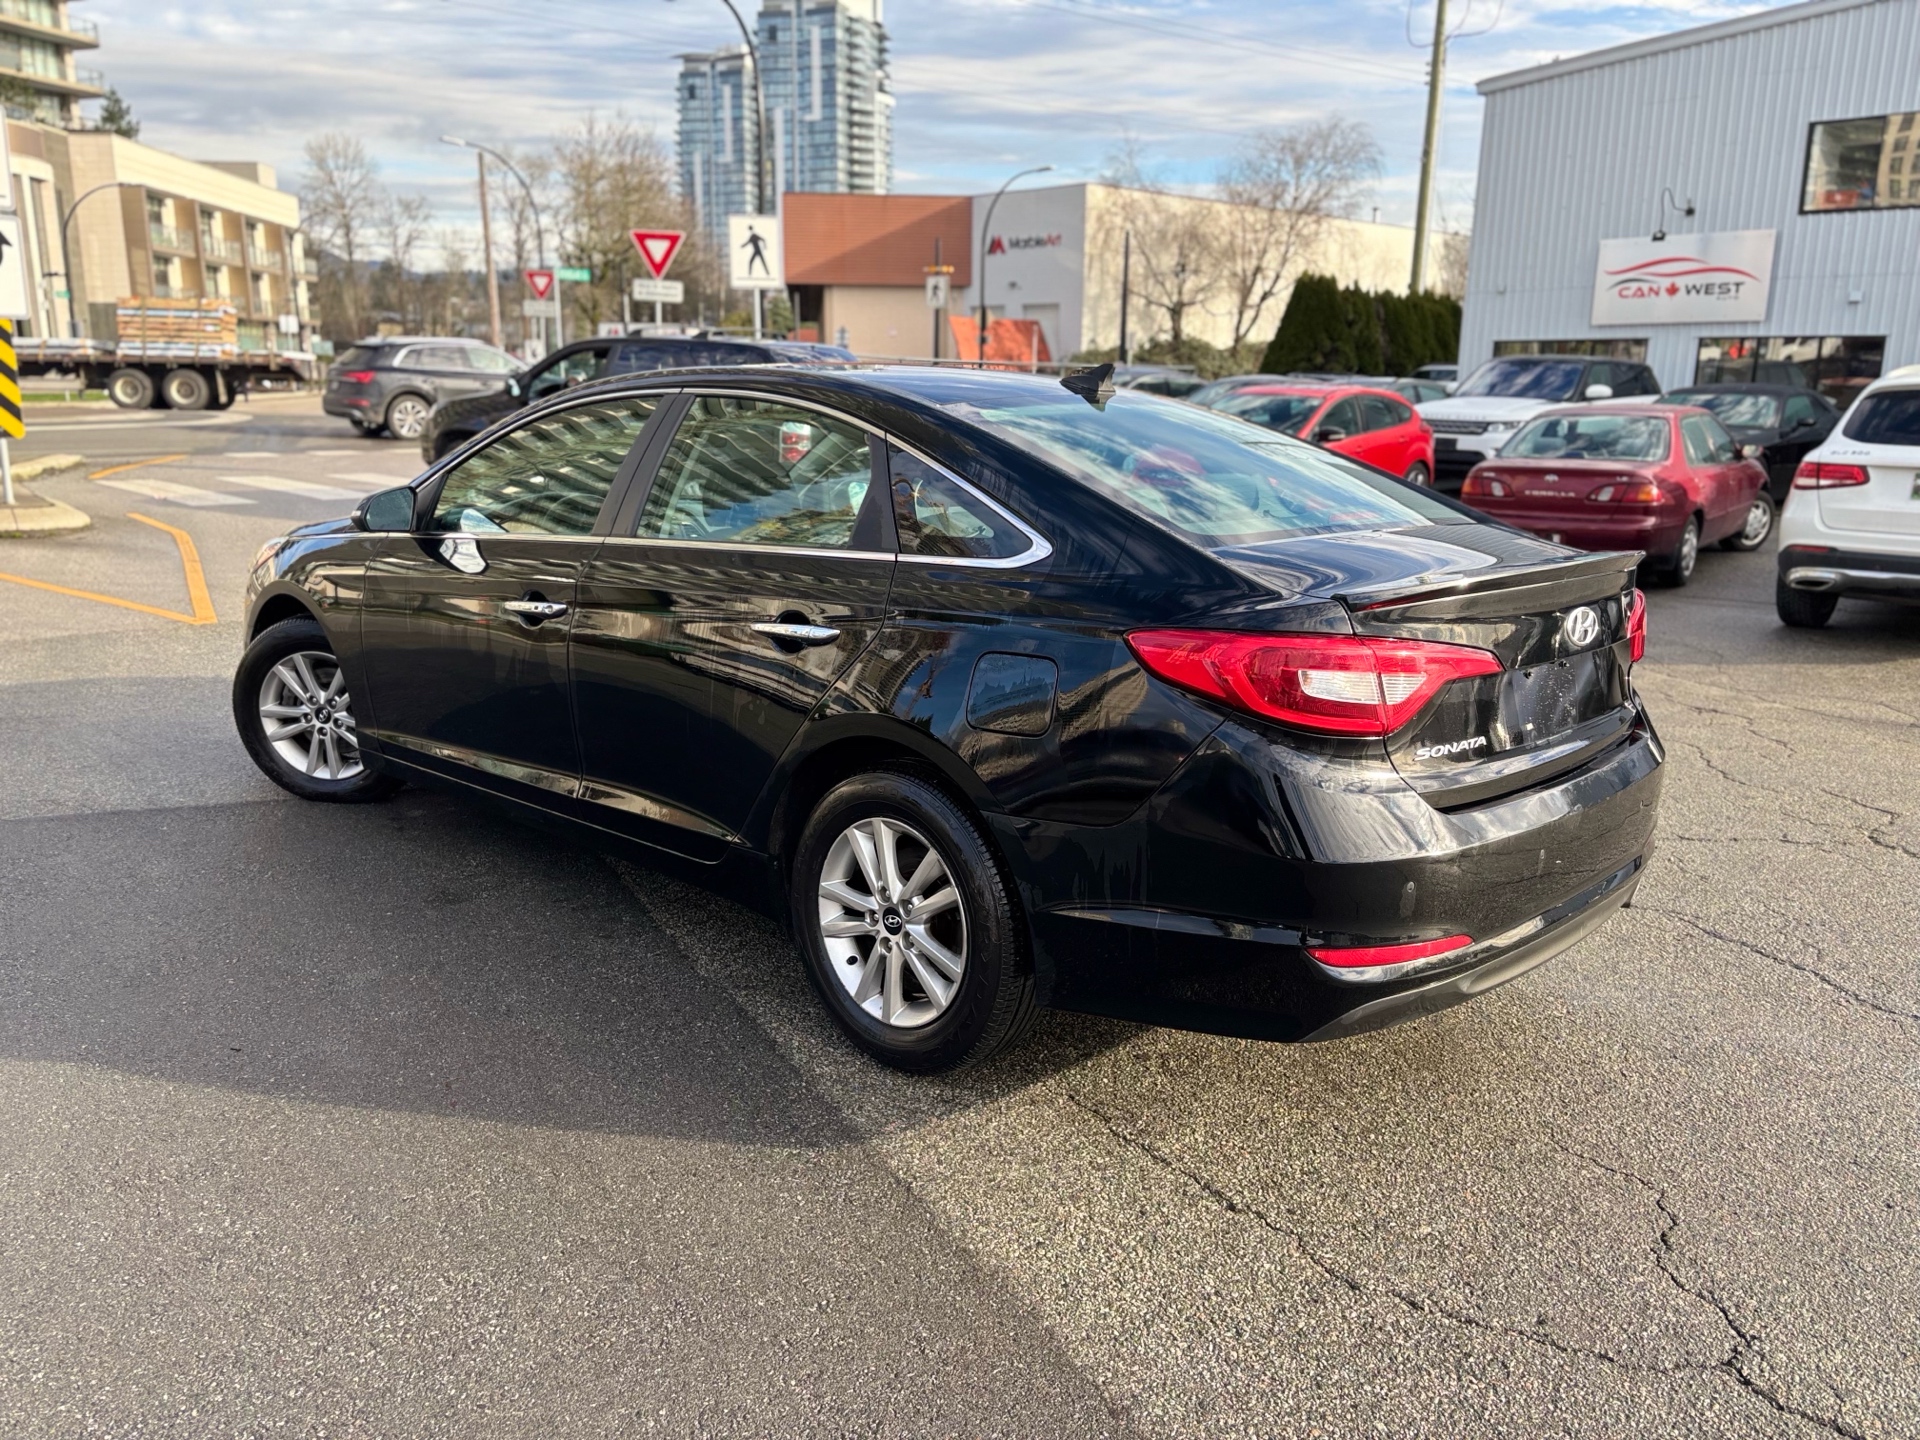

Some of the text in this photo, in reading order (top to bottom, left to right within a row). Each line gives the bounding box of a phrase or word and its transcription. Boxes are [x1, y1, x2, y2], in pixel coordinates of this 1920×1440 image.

[1618, 282, 1745, 298] CAN WEST
[1413, 735, 1487, 762] SONATA
